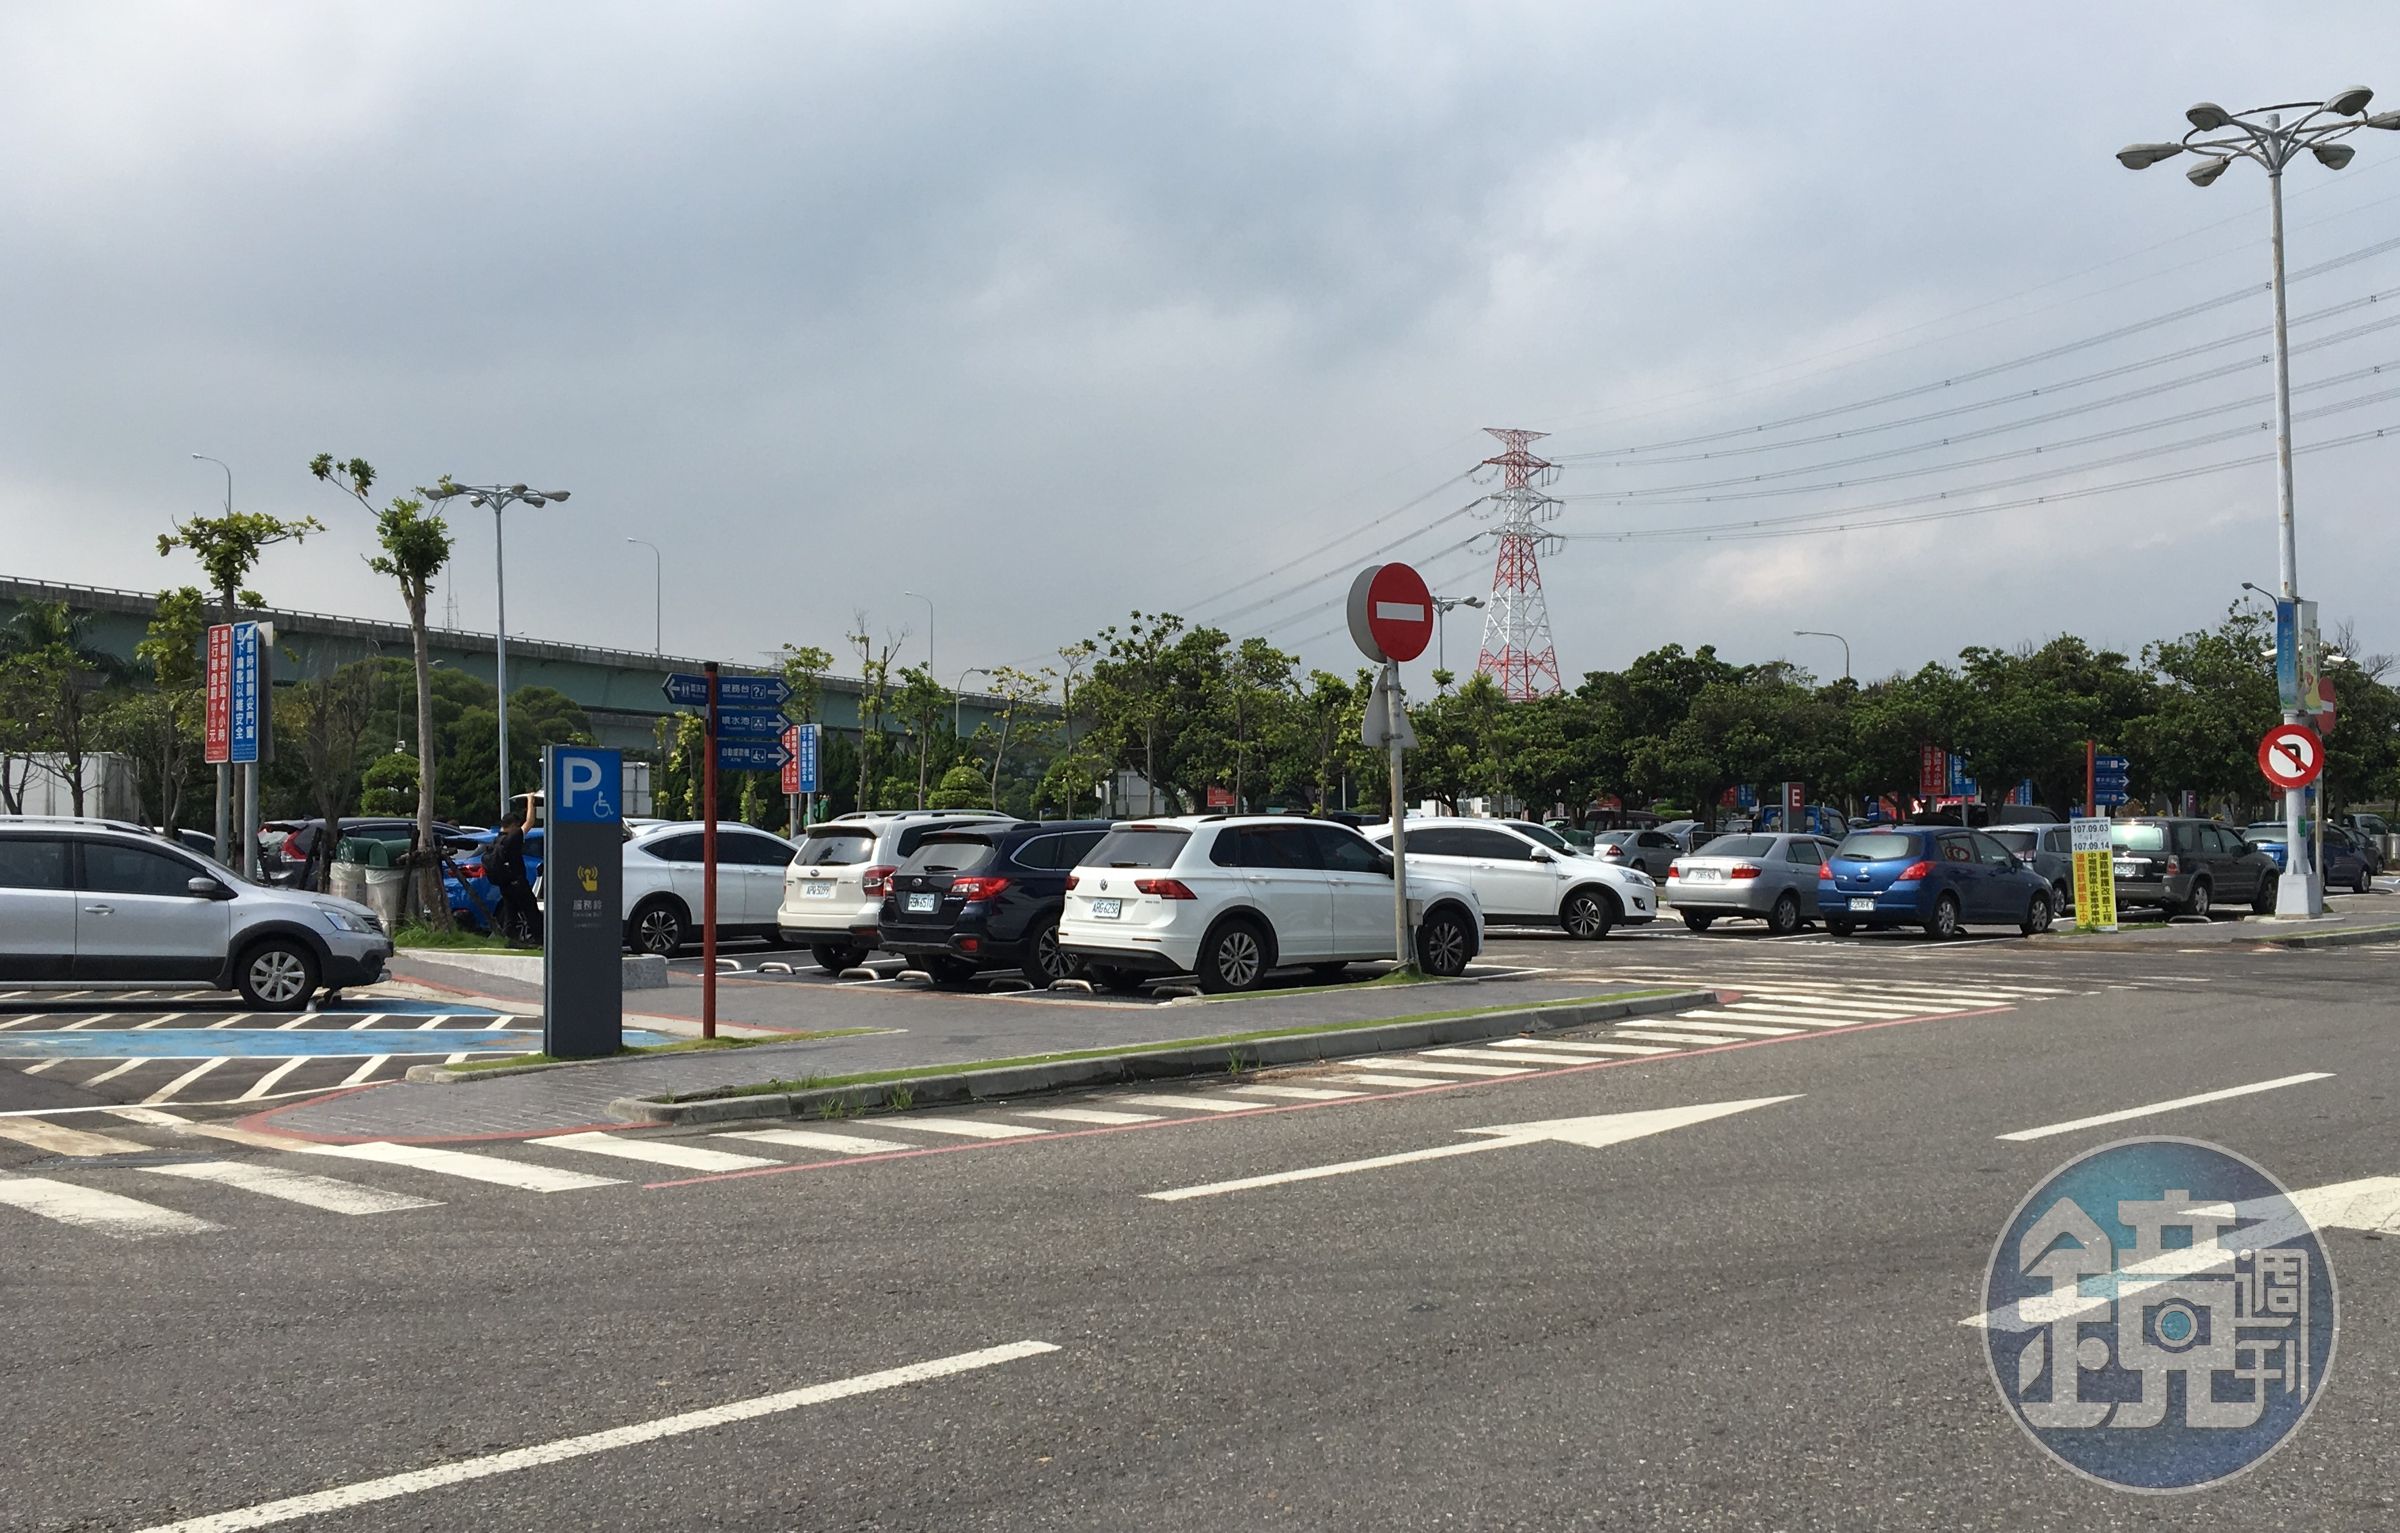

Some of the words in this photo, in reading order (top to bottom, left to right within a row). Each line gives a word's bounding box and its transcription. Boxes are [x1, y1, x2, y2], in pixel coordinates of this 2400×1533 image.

[721, 683, 750, 694] 服務台
[721, 715, 750, 725] 噴水池
[562, 756, 602, 808] P
[1792, 788, 1801, 807] E
[2073, 824, 2109, 833] 107.09.03
[2073, 841, 2110, 850] 107.09.14
